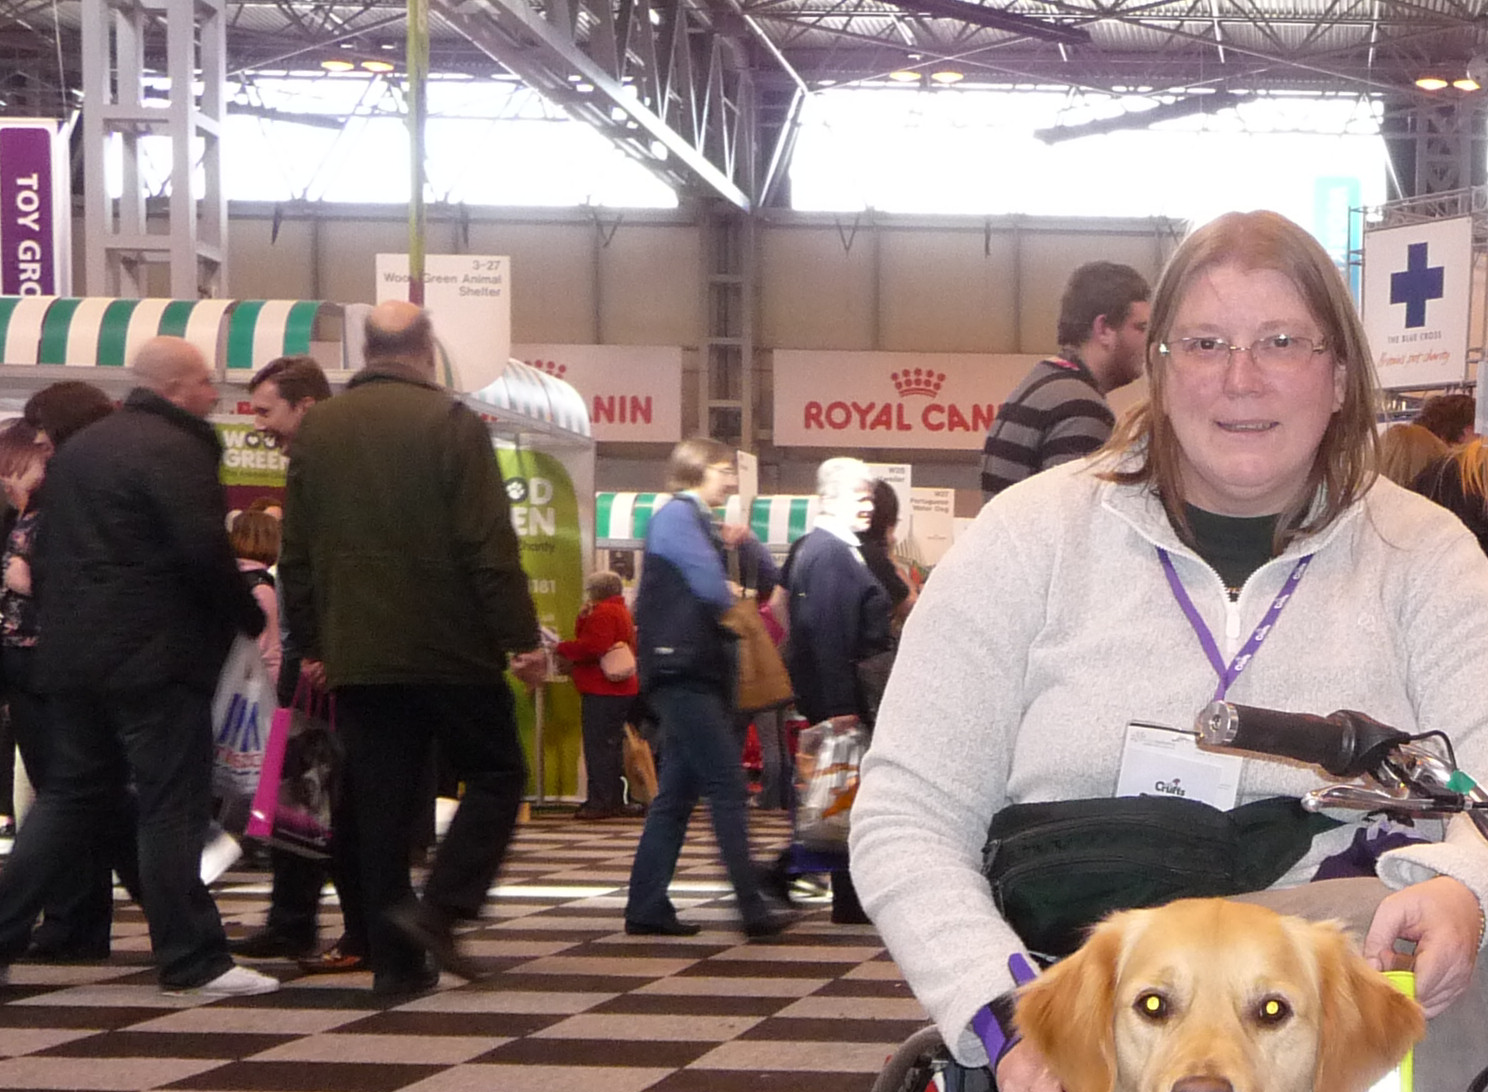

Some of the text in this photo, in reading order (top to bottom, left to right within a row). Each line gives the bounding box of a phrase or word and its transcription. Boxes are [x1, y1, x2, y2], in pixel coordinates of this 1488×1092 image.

[16, 173, 40, 231] TOY
[423, 273, 457, 284] Green
[462, 274, 502, 284] Animal
[459, 286, 501, 297] Shelter
[804, 401, 912, 431] ROYAL
